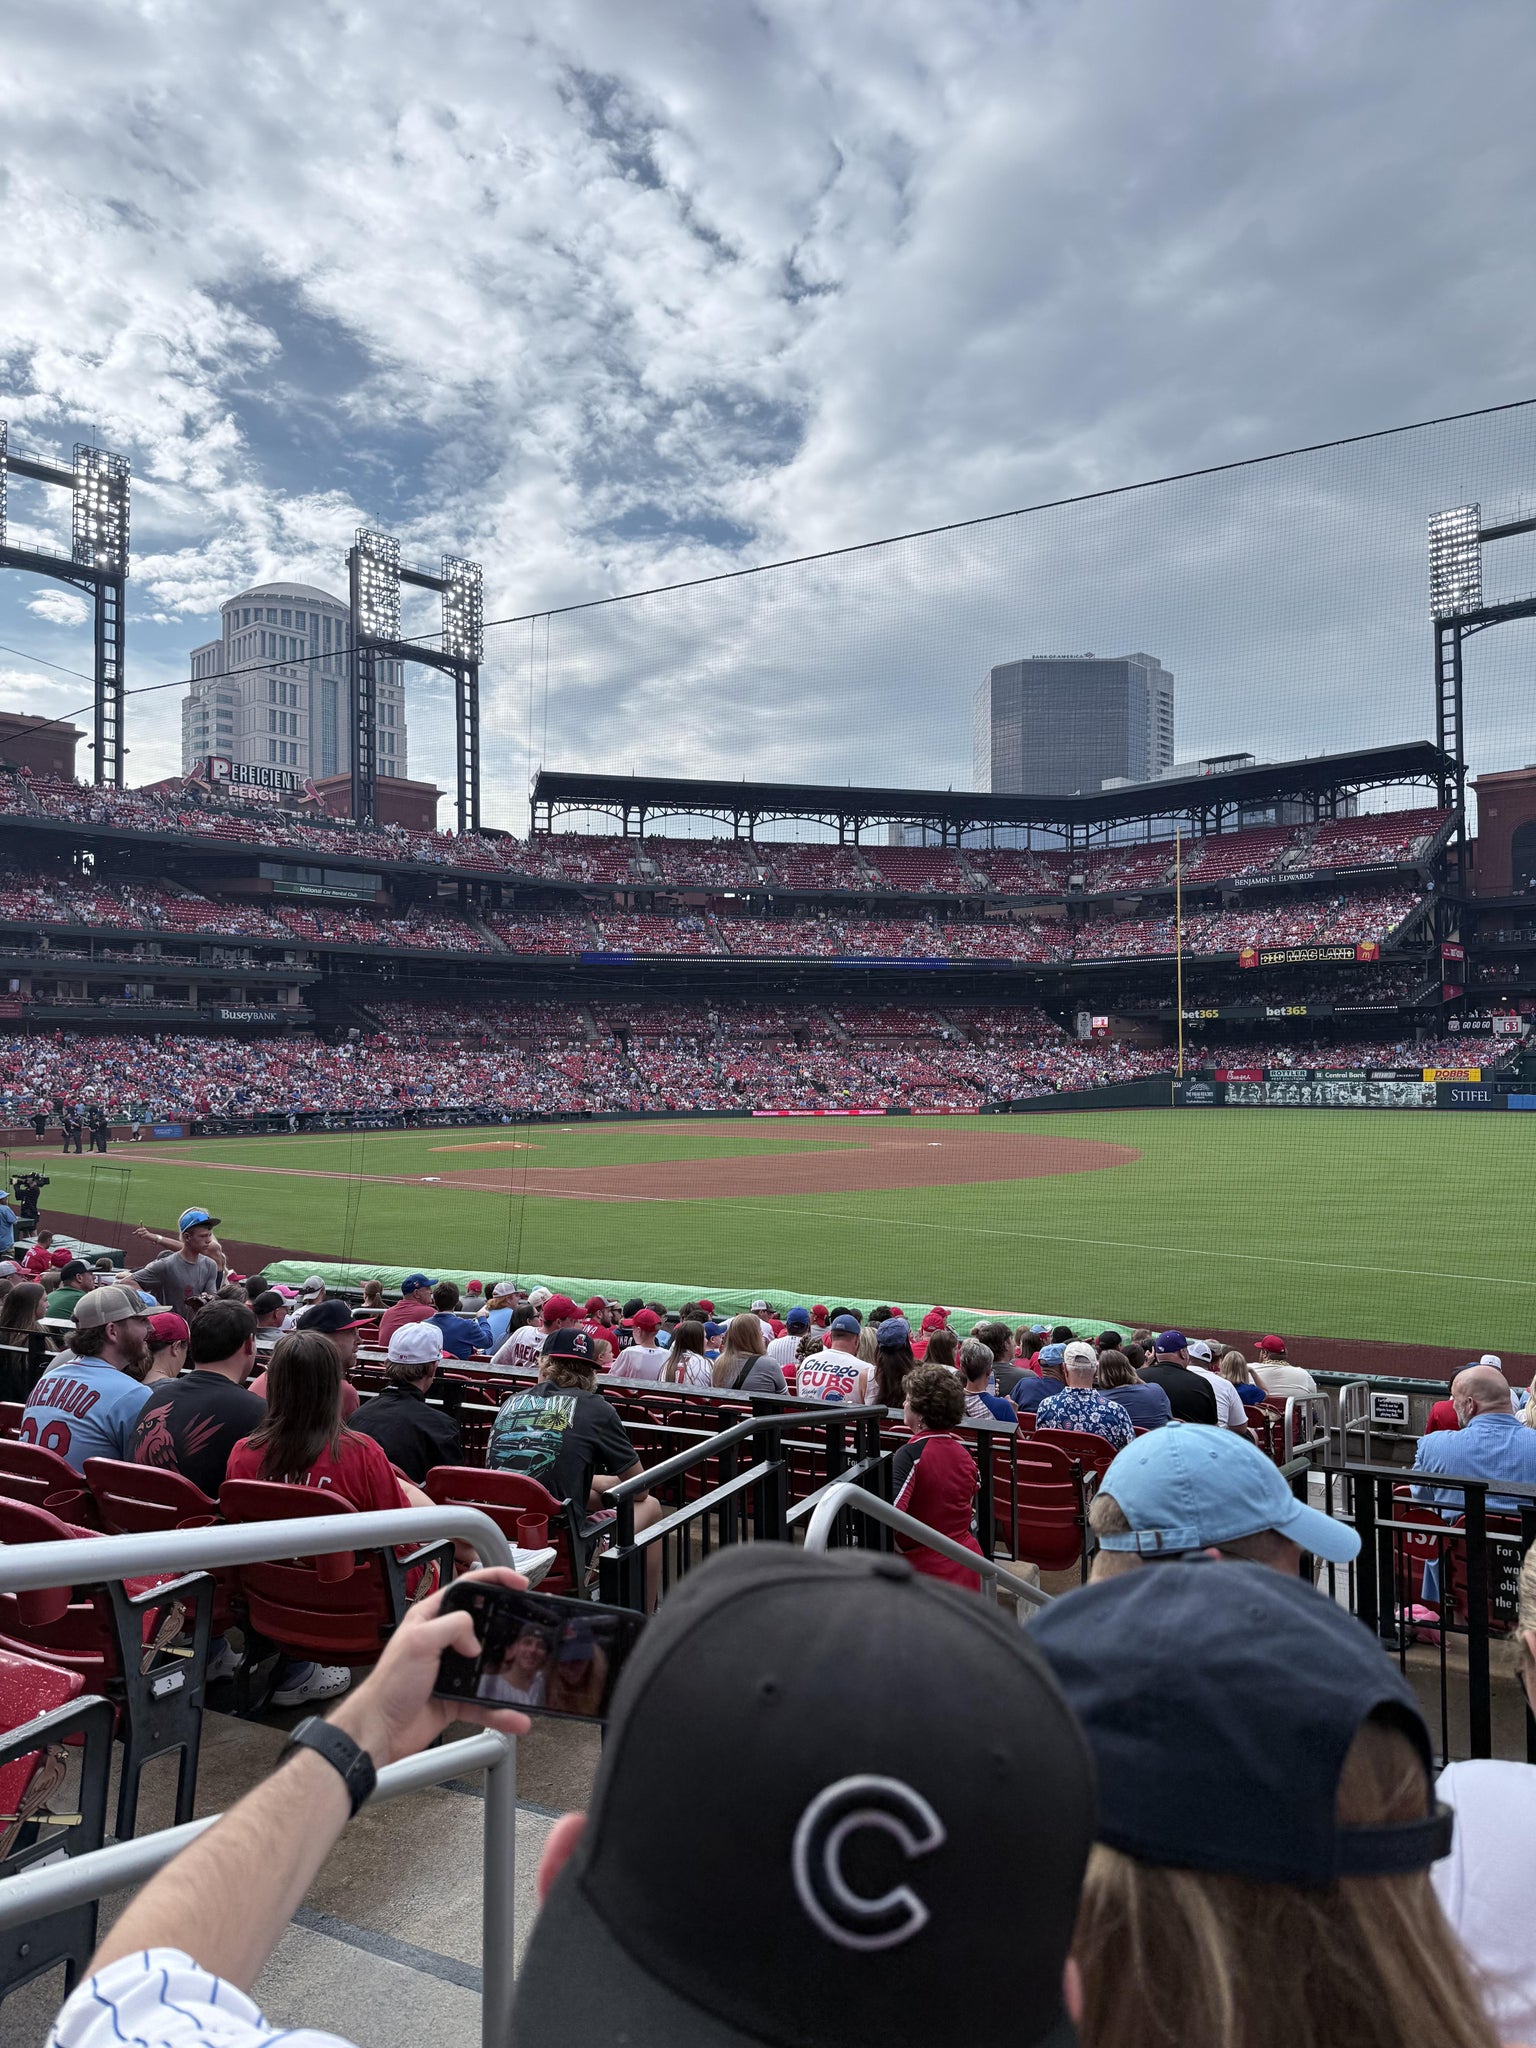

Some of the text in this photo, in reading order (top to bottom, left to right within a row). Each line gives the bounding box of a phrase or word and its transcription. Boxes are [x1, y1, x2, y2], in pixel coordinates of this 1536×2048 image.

[228, 785, 281, 803] PERCH
[1234, 877, 1270, 887] BENJAMIN
[1279, 872, 1315, 882] EDWARDS
[299, 886, 323, 895] National
[347, 890, 359, 898] Club
[1286, 949, 1318, 963] MAC
[1319, 947, 1355, 960] LAND
[1181, 1009, 1219, 1019] bet365
[1265, 1006, 1307, 1016] bet365
[1462, 1021, 1471, 1029] GO
[1472, 1021, 1481, 1029] GO
[1481, 1021, 1490, 1029] GO
[1325, 1071, 1367, 1079] Central Bank
[1434, 1070, 1470, 1078] DOBBS
[1451, 1088, 1492, 1102] STIFEL
[804, 1359, 859, 1378] Chicago
[802, 1370, 854, 1394] CUBS
[1496, 1544, 1513, 1556] For
[1503, 1566, 1521, 1575] wa
[1495, 1596, 1512, 1609] the
[167, 1678, 173, 1689] 3
[793, 1773, 947, 1951] C
